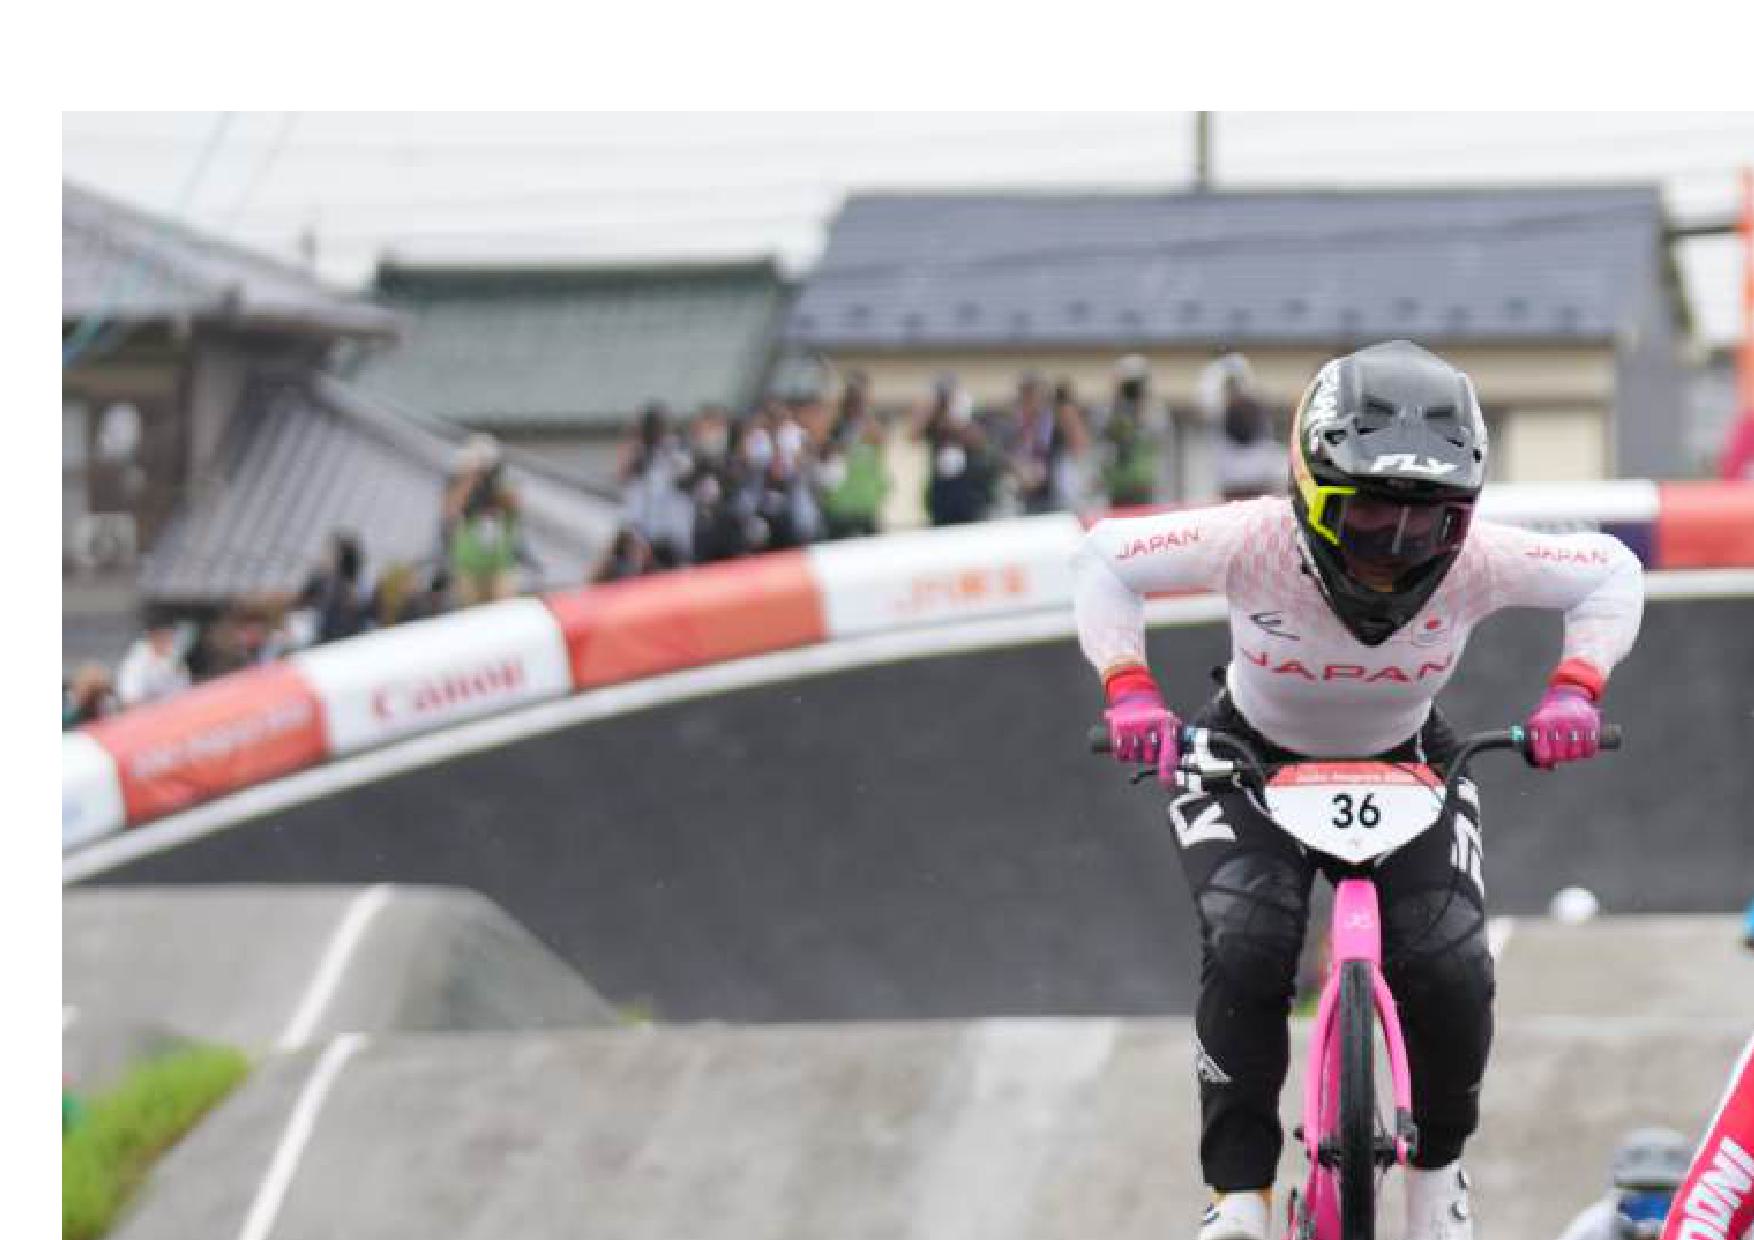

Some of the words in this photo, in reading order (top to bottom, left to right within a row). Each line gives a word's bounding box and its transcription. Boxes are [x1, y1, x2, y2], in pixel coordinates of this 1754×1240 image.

[1370, 453, 1458, 474] FLY
[1114, 525, 1201, 561] JAPAN
[1524, 545, 1611, 565] JAPAN
[1240, 648, 1454, 682] JAPAN
[370, 655, 524, 721] Canon
[1330, 793, 1382, 829] 36
